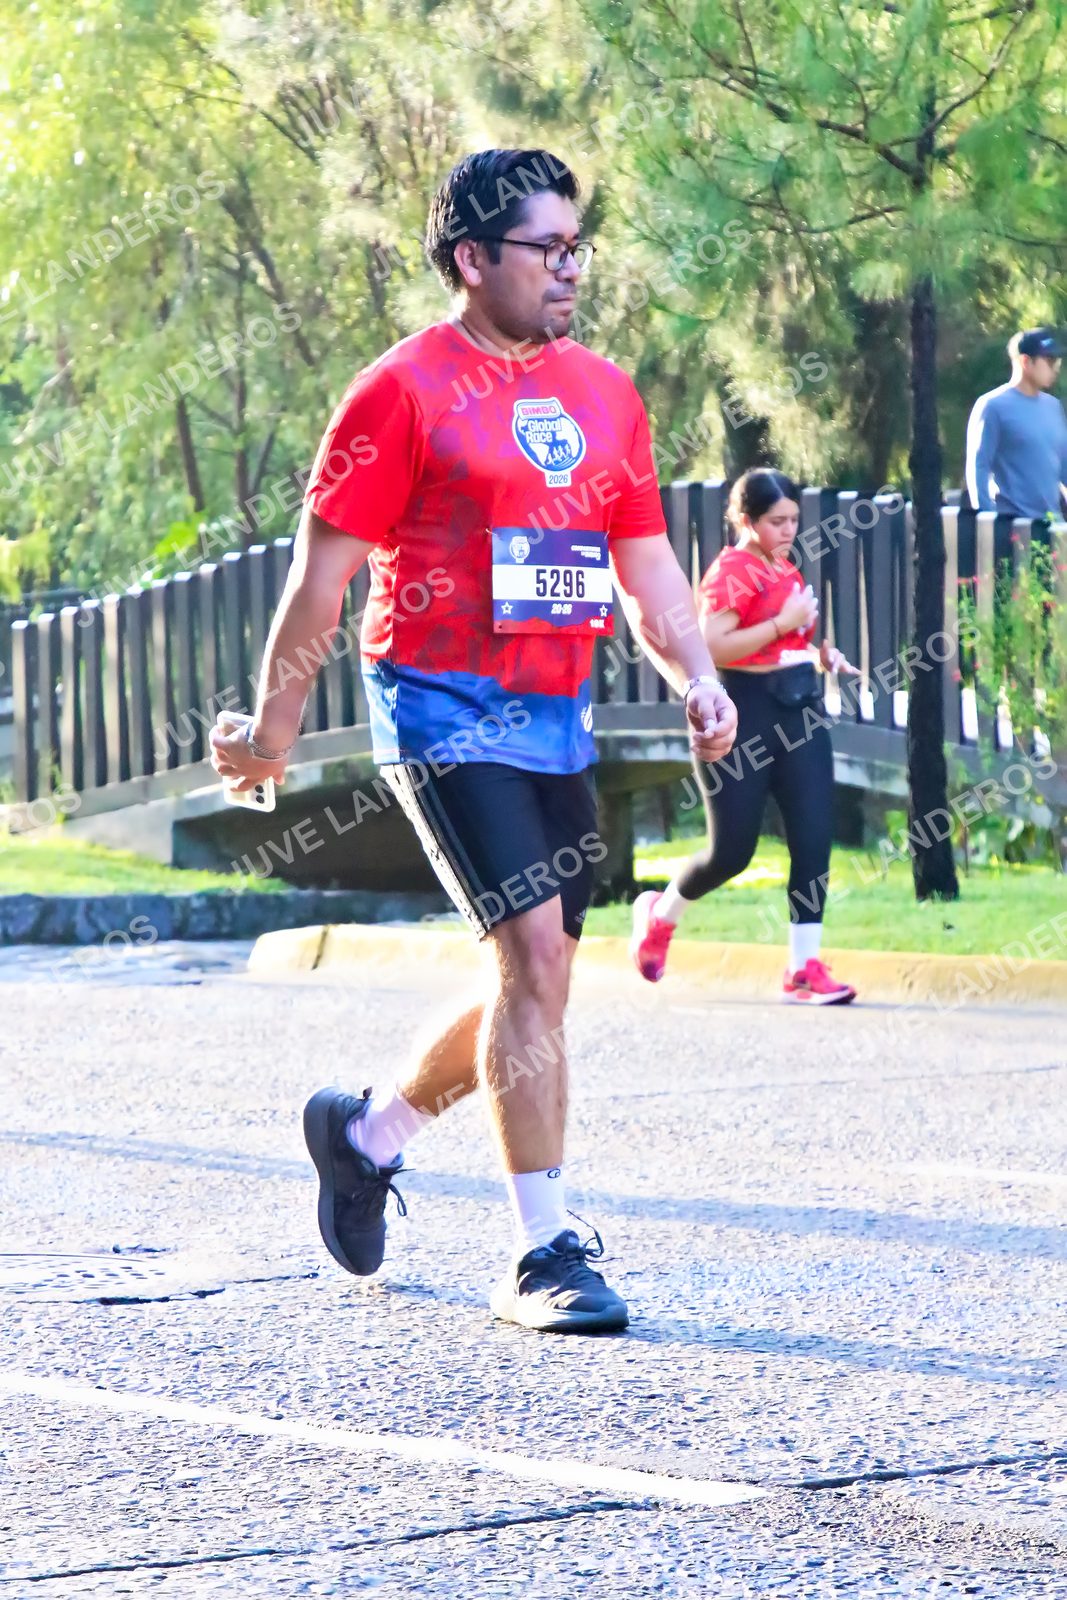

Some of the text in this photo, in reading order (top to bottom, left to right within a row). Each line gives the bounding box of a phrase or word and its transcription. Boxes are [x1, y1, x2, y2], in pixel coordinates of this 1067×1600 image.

[521, 405, 557, 416] BIMBO
[528, 418, 562, 432] Global
[526, 430, 553, 443] Race
[548, 474, 569, 485] 2026
[536, 568, 585, 599] 5296
